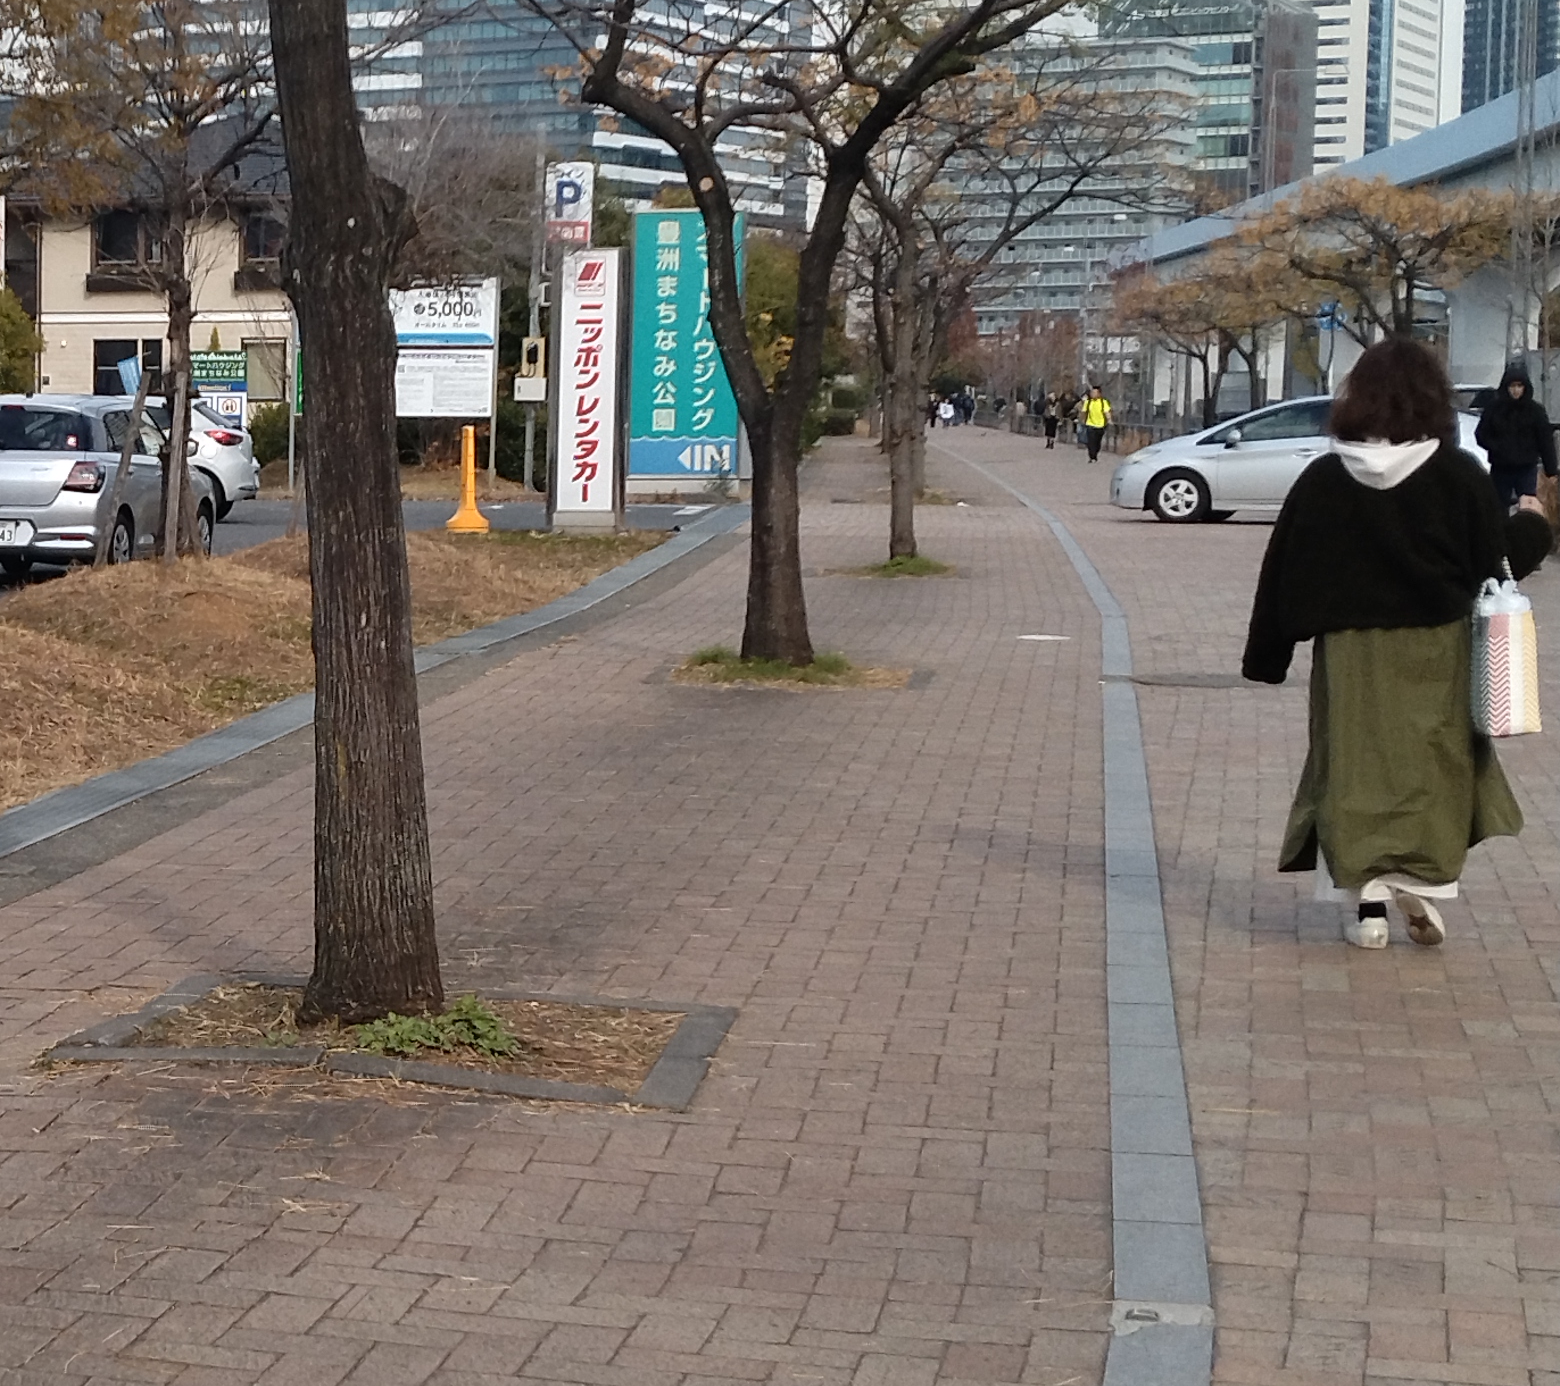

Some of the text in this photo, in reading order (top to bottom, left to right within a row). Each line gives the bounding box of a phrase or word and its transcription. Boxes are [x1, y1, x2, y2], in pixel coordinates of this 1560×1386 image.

[555, 180, 582, 217] P
[571, 303, 604, 503] ニッポンレンタカー
[693, 444, 731, 472] IN
